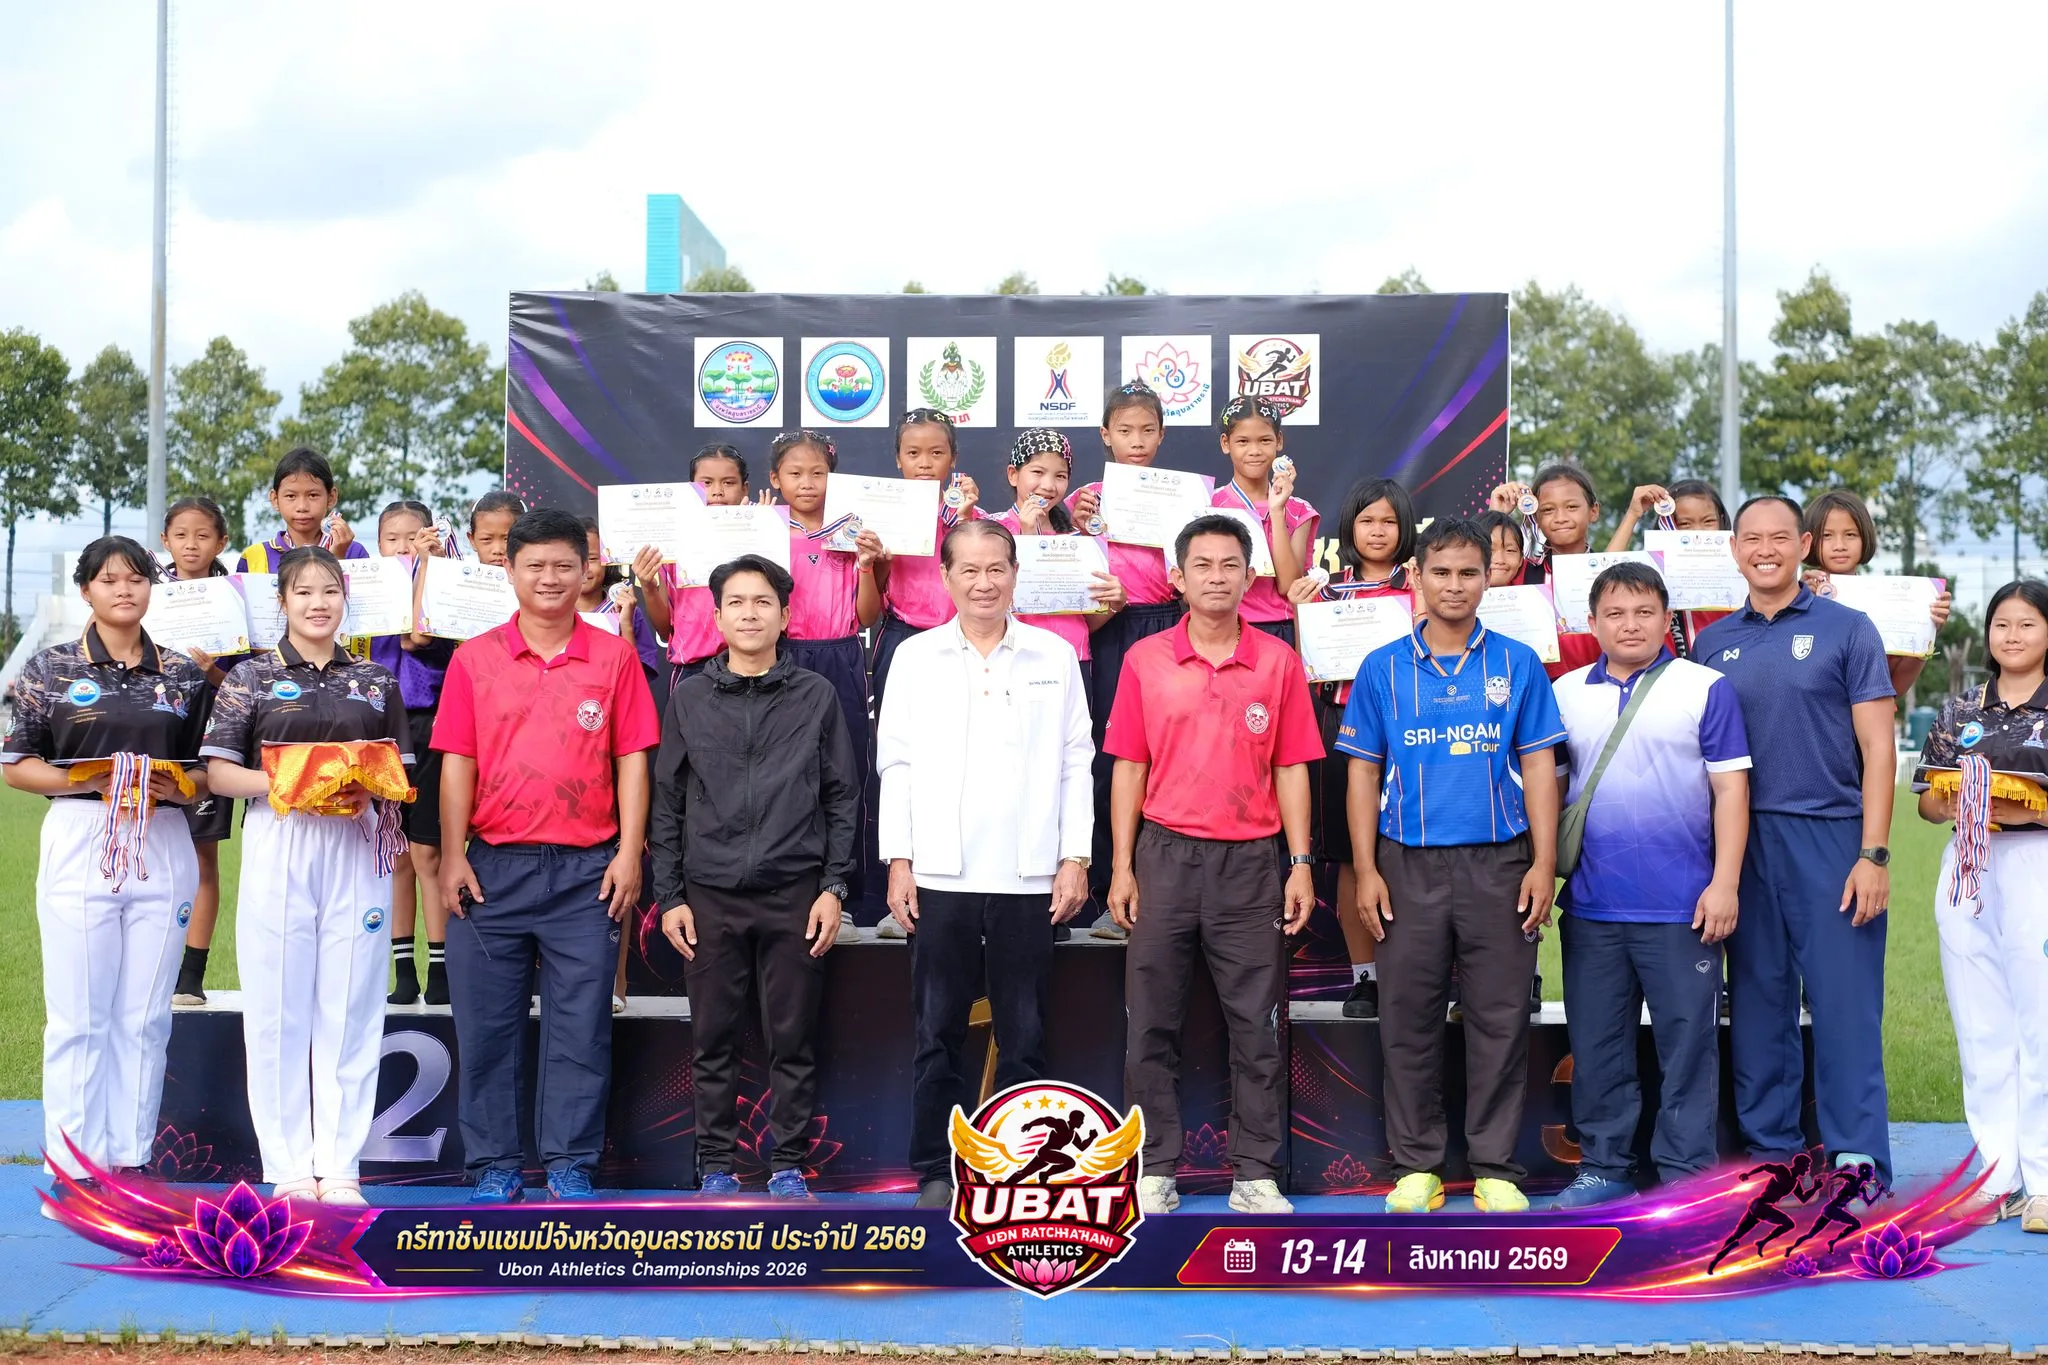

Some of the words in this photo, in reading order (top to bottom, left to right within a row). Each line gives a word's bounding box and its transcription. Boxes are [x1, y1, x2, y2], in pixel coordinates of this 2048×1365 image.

[1244, 380, 1305, 397] UBAT
[1040, 402, 1077, 411] NSDF
[1403, 722, 1501, 746] SRI-NGAM
[1471, 740, 1500, 753] Tour
[360, 1030, 451, 1162] 2
